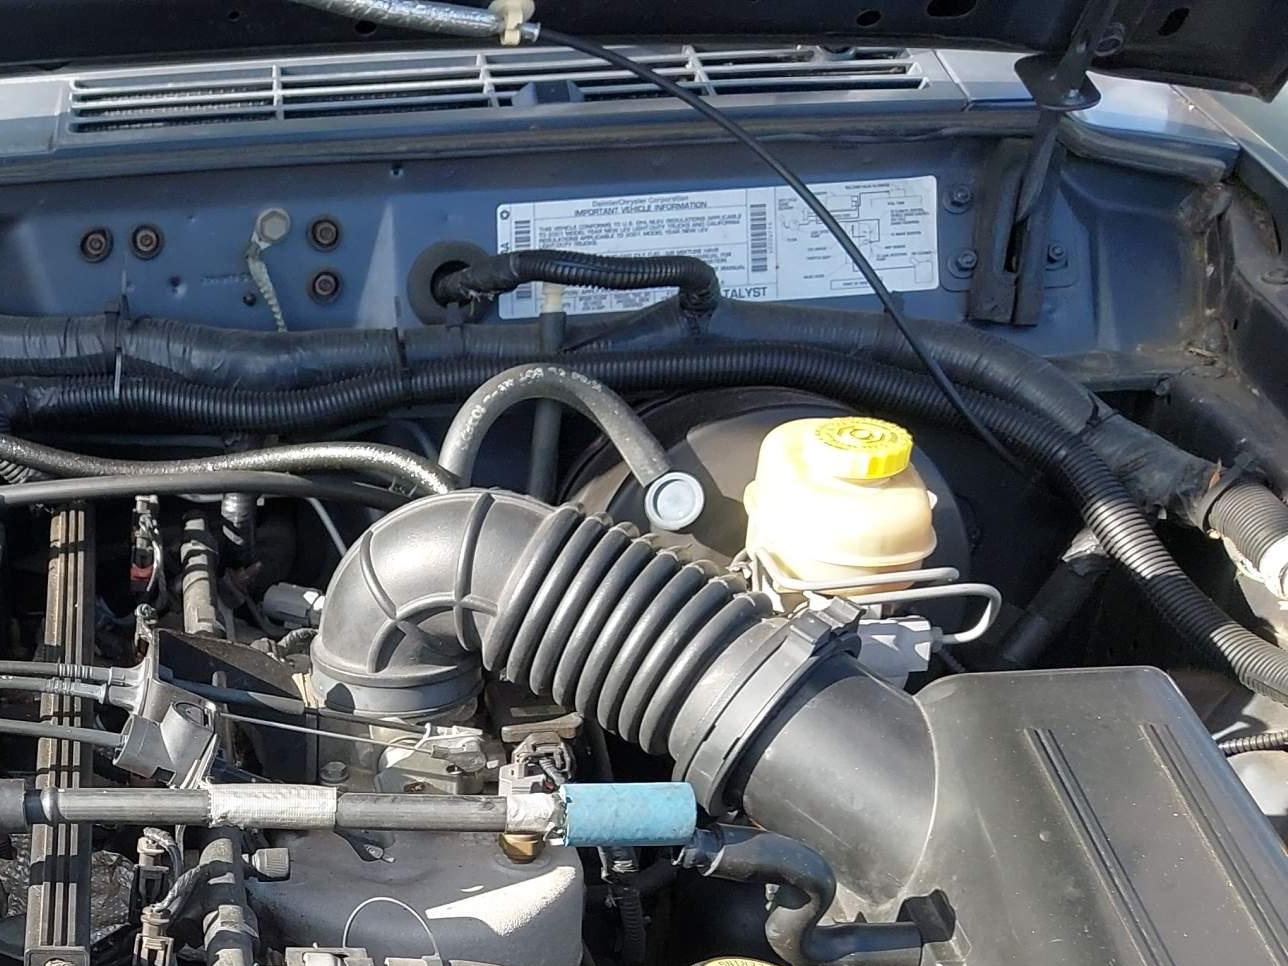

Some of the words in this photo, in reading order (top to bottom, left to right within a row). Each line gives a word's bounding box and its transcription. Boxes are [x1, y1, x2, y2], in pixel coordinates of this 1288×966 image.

[575, 208, 618, 217] IMPORTANT
[622, 204, 650, 214] VEHICLE
[654, 201, 707, 212] INFORMATION
[723, 286, 768, 299] TALYST
